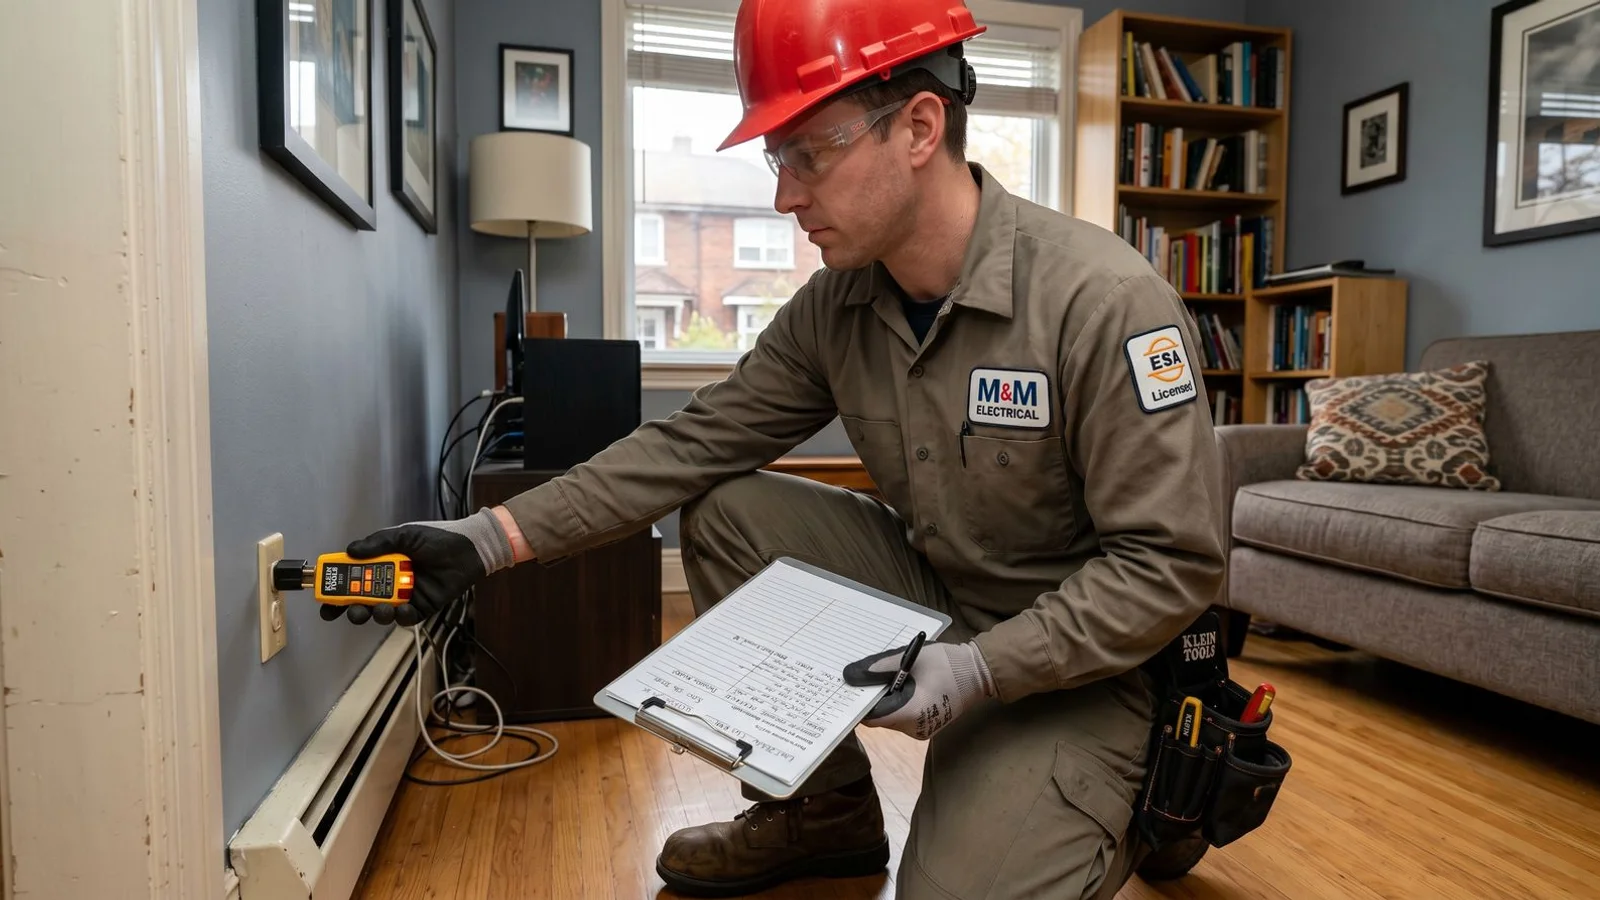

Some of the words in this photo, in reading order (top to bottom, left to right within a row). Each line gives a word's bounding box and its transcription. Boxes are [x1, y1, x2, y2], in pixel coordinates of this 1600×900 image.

[1149, 350, 1182, 371] ESA
[978, 378, 1037, 406] M&M
[1151, 381, 1193, 402] Licensed
[976, 405, 1039, 420] ELECTRICAL
[1183, 632, 1217, 648] KLEIN
[1183, 645, 1215, 662] TOOLS
[1183, 714, 1192, 736] KLEIN
